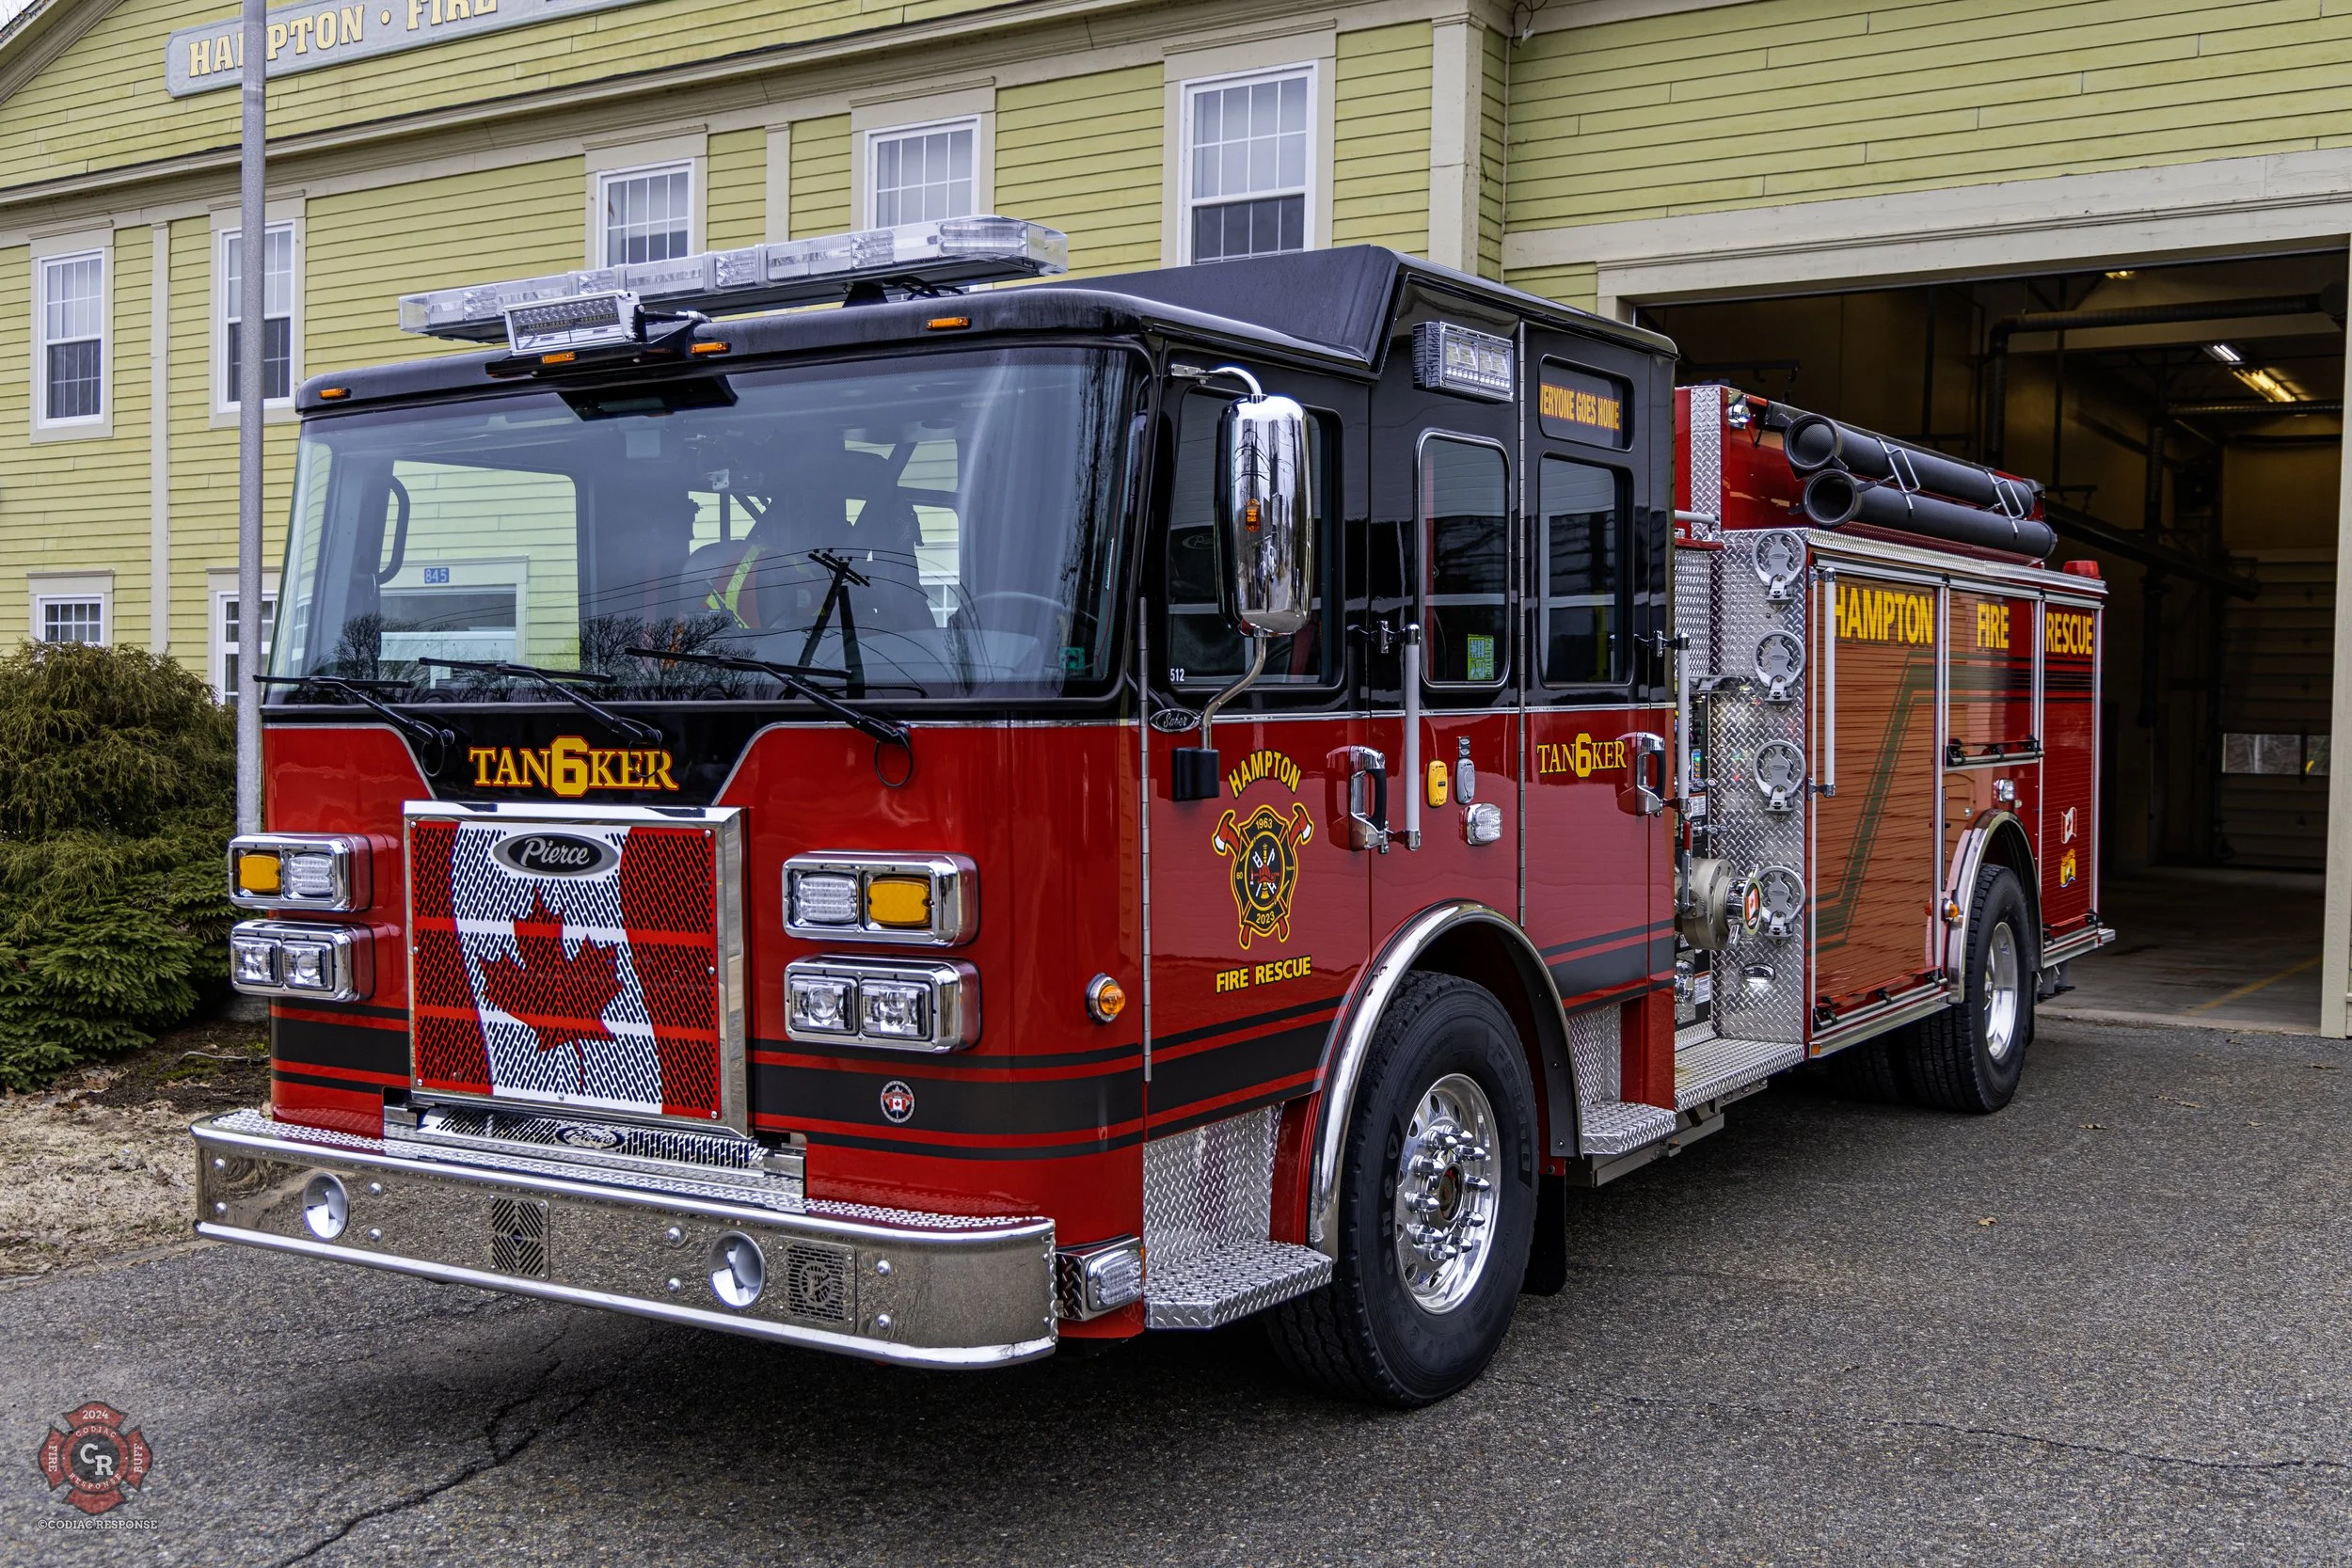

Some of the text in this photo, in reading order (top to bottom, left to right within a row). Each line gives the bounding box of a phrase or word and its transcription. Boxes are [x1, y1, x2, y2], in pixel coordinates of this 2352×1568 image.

[1576, 391, 1597, 425] GOES
[1597, 397, 1620, 430] HOME
[425, 568, 447, 583] 845
[1835, 585, 2093, 655] HAMPTON FIRE RESCUE
[1169, 668, 1185, 682] 512
[1228, 750, 1302, 799] HAMPTON
[1255, 816, 1273, 830] 1963
[519, 836, 590, 866] Pierce
[1255, 911, 1276, 925] 2023
[1216, 957, 1311, 993] FIRE RESCUE
